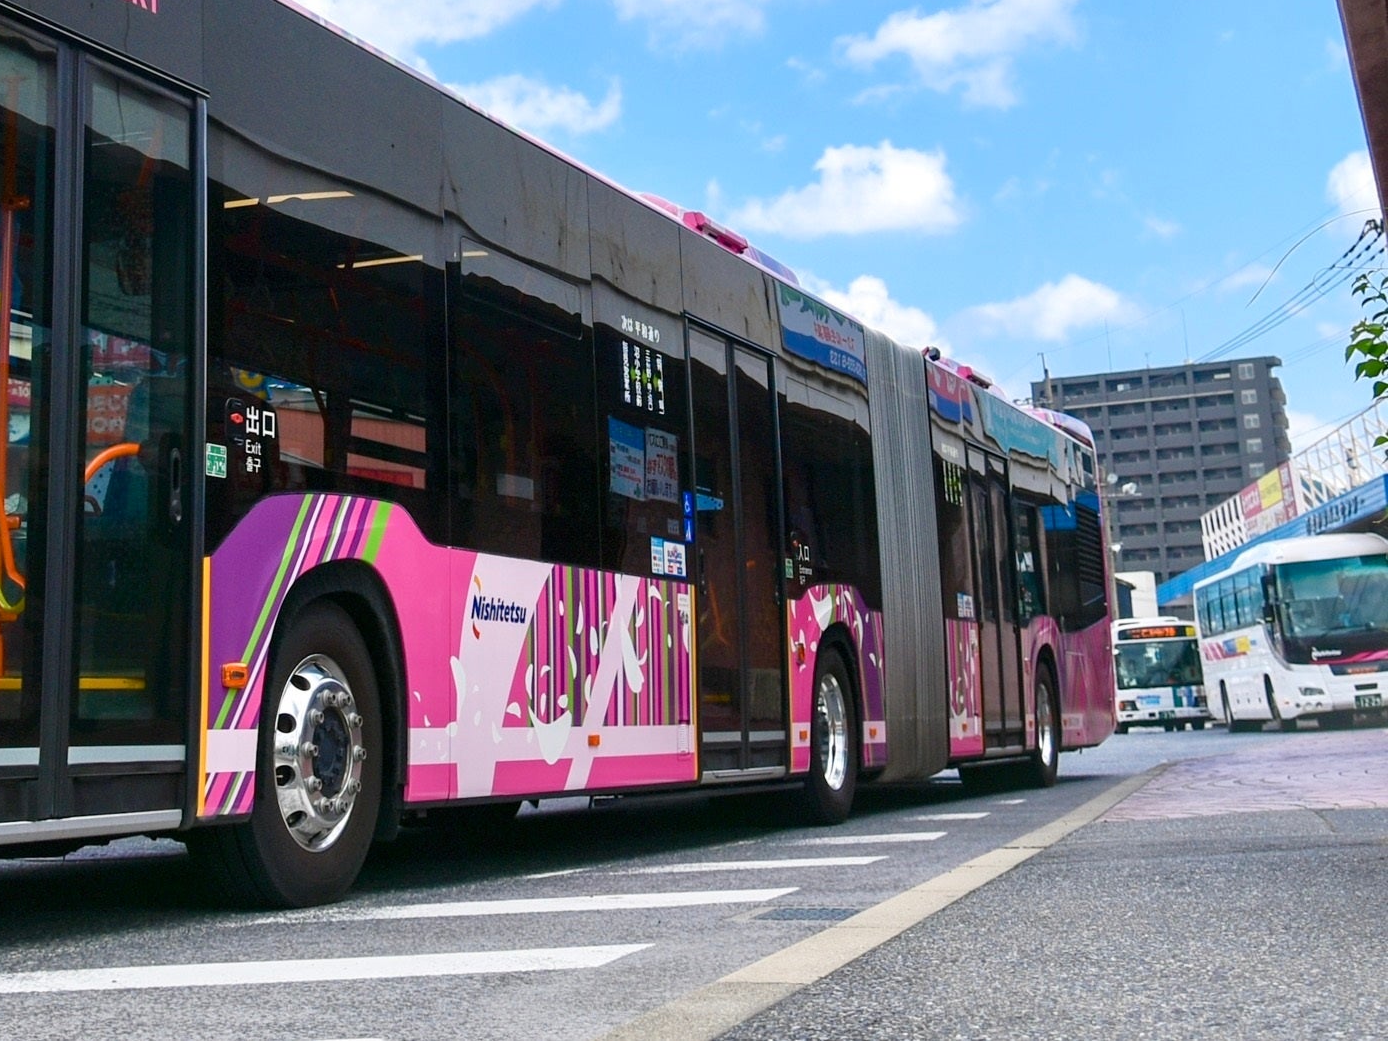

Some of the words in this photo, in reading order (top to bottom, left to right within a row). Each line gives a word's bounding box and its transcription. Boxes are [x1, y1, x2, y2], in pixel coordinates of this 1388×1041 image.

[245, 406, 275, 438] 出口
[245, 439, 262, 455] Exit
[245, 456, 262, 473] 출구
[798, 543, 810, 561] 入口
[470, 594, 527, 624] Nishitetsu
